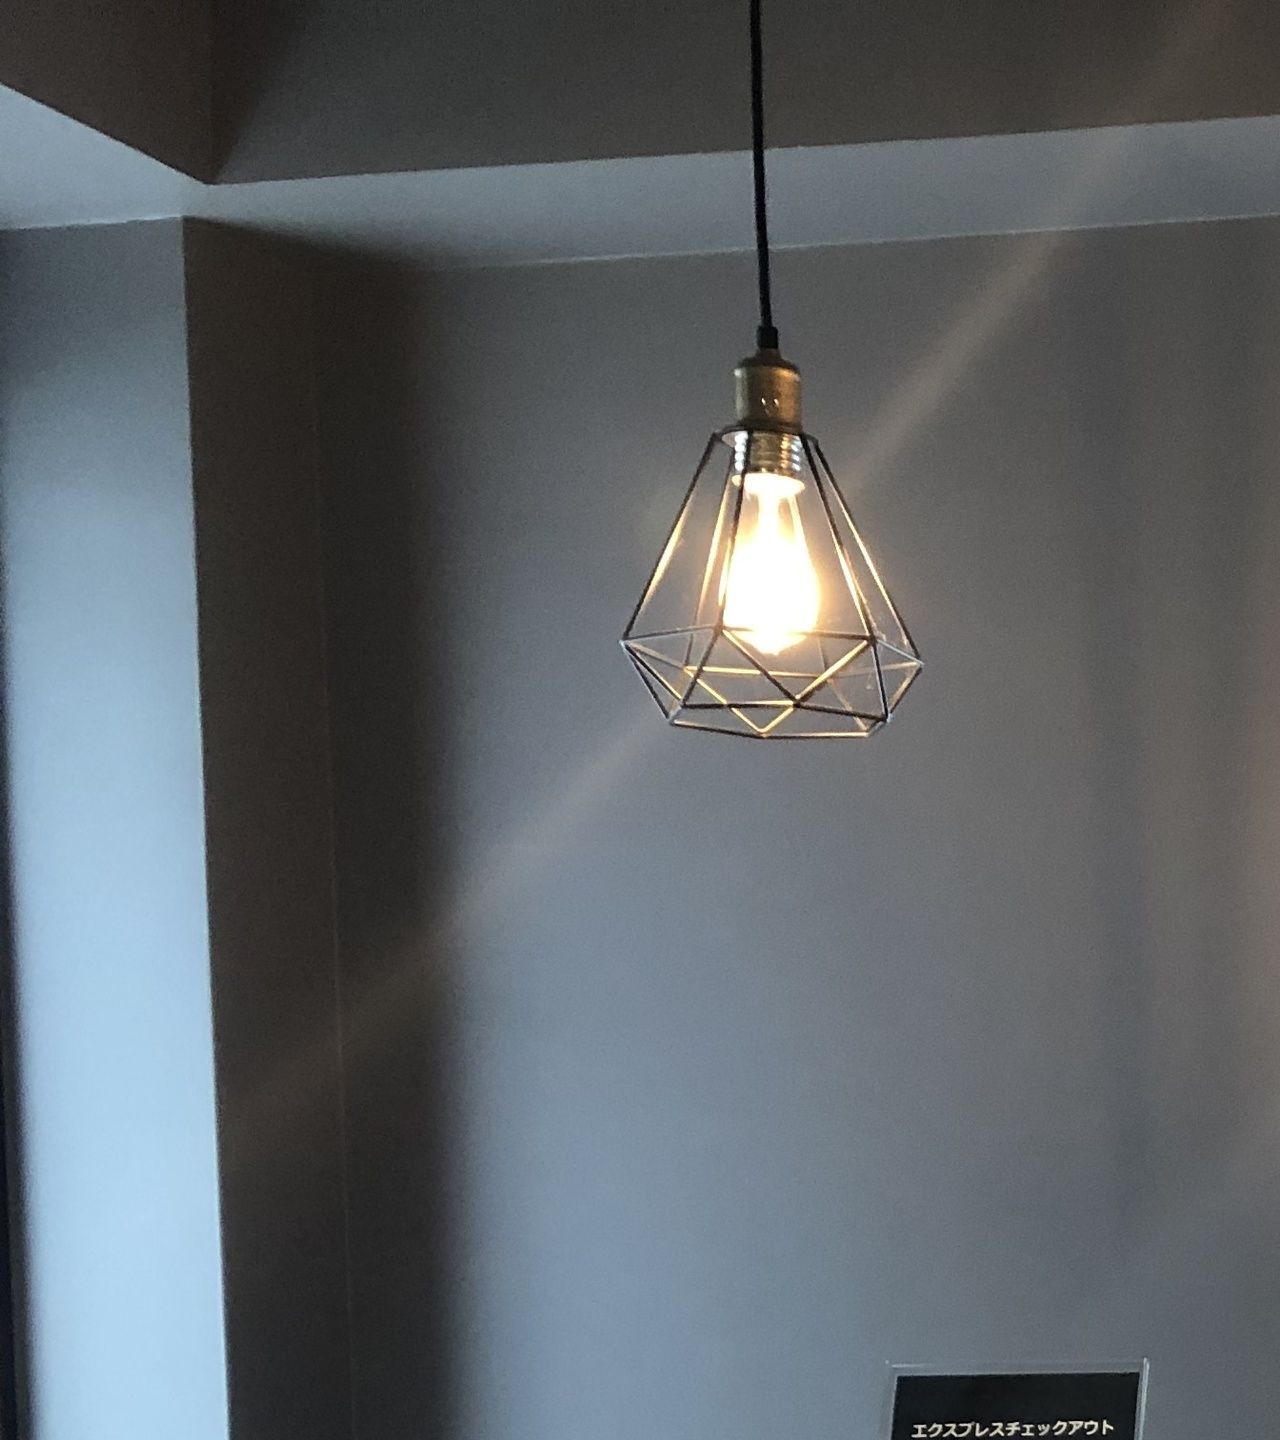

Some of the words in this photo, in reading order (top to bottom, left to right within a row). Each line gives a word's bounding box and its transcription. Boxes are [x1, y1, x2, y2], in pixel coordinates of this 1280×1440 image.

[911, 1420, 1114, 1438] エクスプレスチェックアウト
